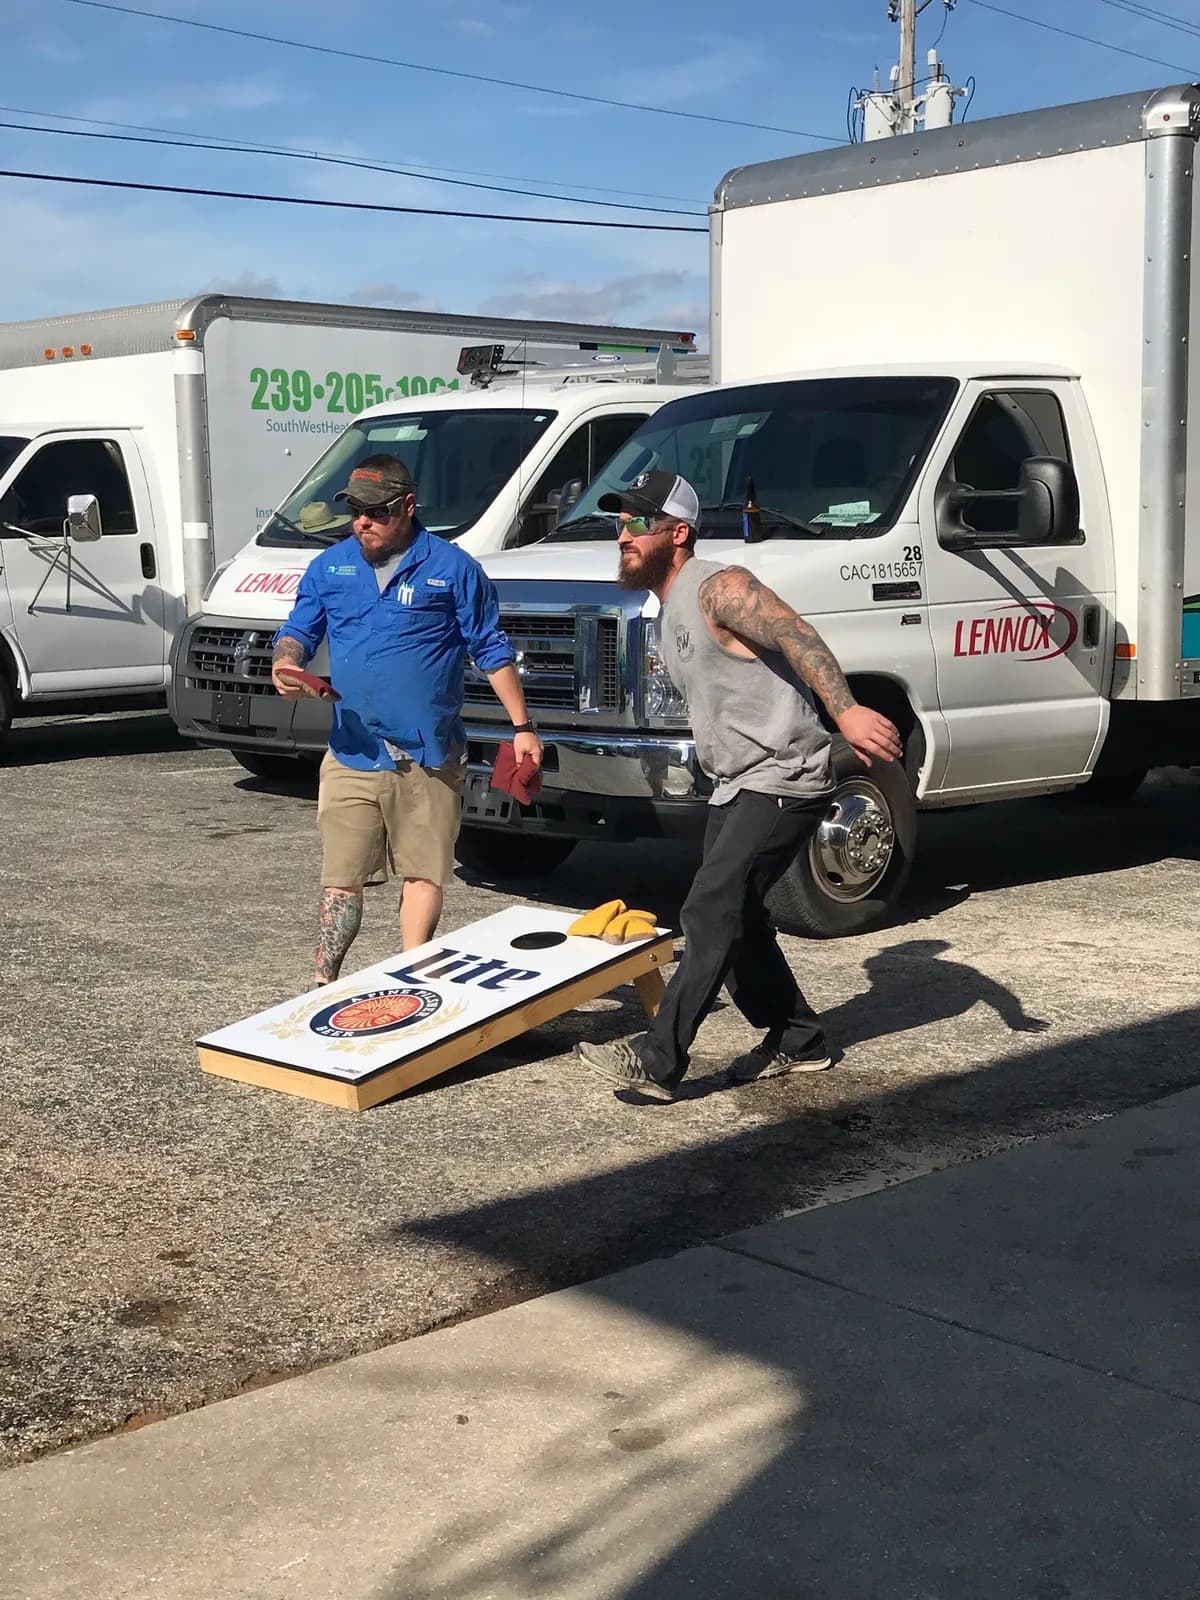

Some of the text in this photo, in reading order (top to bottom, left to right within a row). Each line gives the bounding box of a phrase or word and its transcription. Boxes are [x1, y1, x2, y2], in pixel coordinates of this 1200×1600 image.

[903, 545, 922, 562] 28
[840, 562, 923, 581] CAC1815657
[954, 614, 1056, 657] LENNOX
[384, 947, 542, 990] Lite
[367, 988, 412, 999] FINE
[413, 990, 440, 1017] PILSNER
[315, 1025, 355, 1038] BEER
